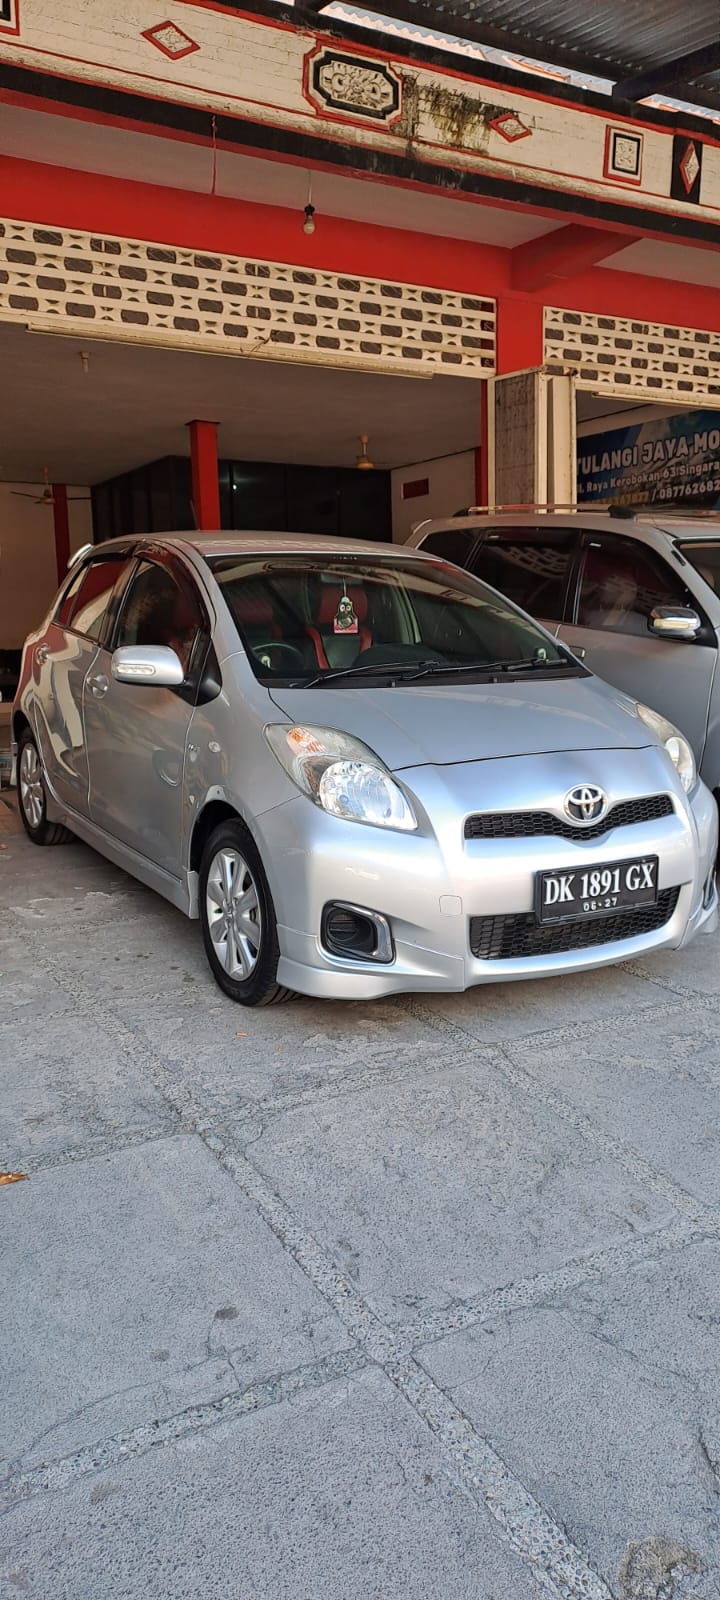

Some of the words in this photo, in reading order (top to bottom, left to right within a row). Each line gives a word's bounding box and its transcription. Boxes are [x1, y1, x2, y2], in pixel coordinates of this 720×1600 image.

[642, 436, 688, 463] JAYA
[694, 429, 720, 454] MO
[587, 481, 608, 494] Raya
[610, 472, 661, 489] Kerobokan
[544, 875, 575, 905] DK
[580, 868, 621, 899] 1891
[625, 863, 654, 891] GX
